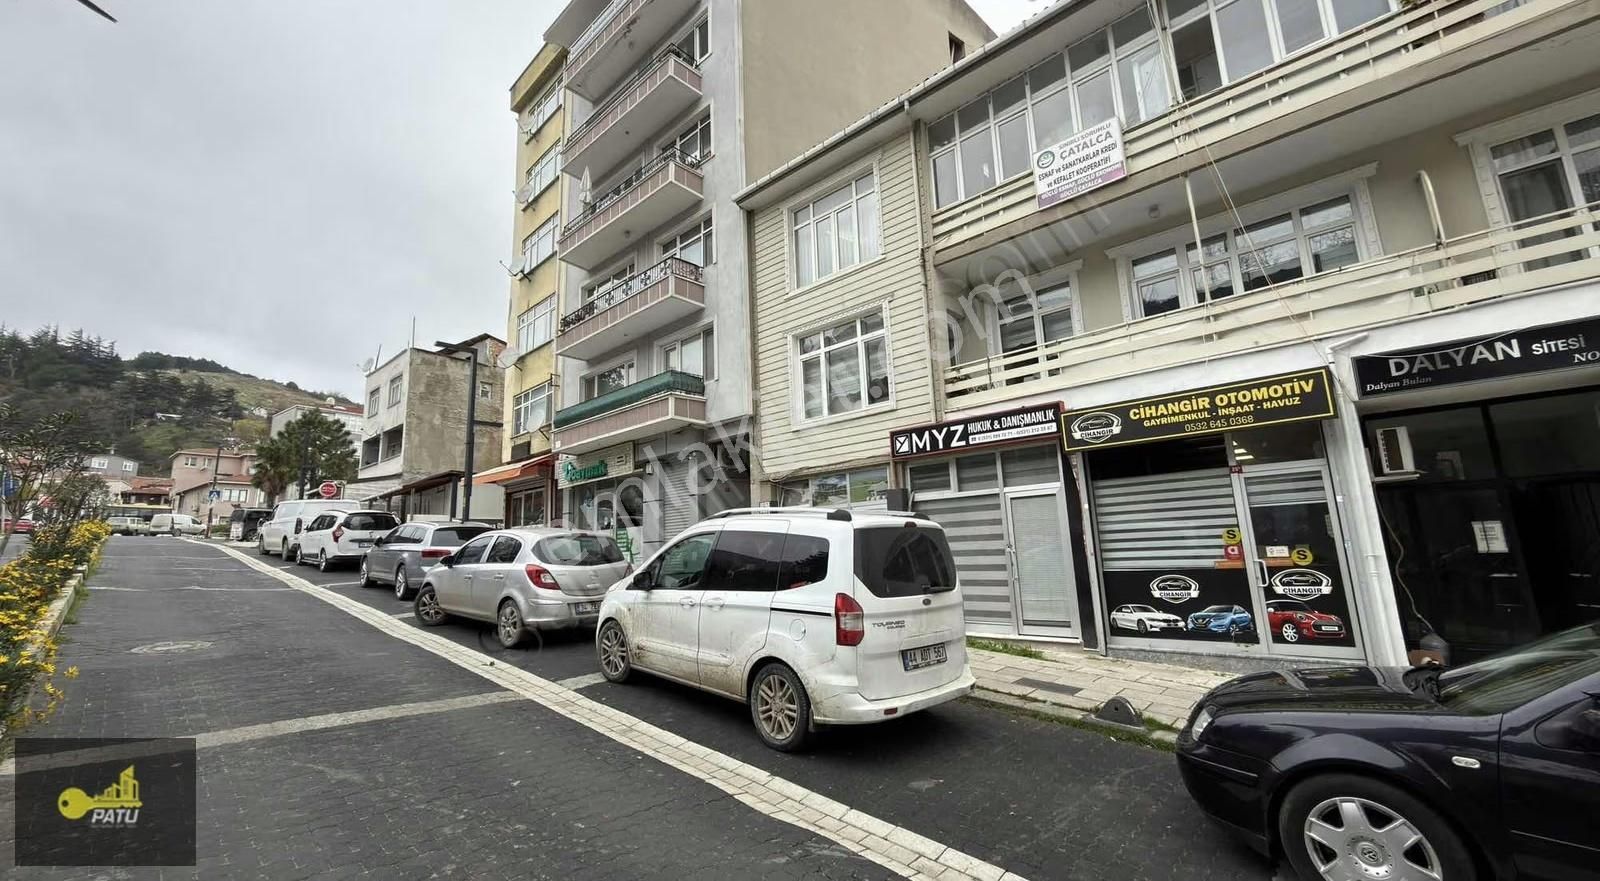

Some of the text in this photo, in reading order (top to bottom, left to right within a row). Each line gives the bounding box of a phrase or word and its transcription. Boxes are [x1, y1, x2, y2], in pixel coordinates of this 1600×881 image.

[1060, 130, 1113, 161] ÇATALCA
[1388, 334, 1586, 377] DALYAN SİTESİ
[1366, 375, 1432, 392] Dalyan Bulan
[1128, 378, 1314, 421] CİHANGİR OTOMOTİV
[1143, 410, 1212, 427] GAYRİMENKUL
[1217, 404, 1255, 416] İNŞAAT
[1263, 396, 1301, 409] HAVUZ
[967, 408, 1055, 434] HUKUK & DANIŞMANLIK
[1184, 415, 1254, 432] 0532 645 0368
[911, 424, 966, 453] MYZ
